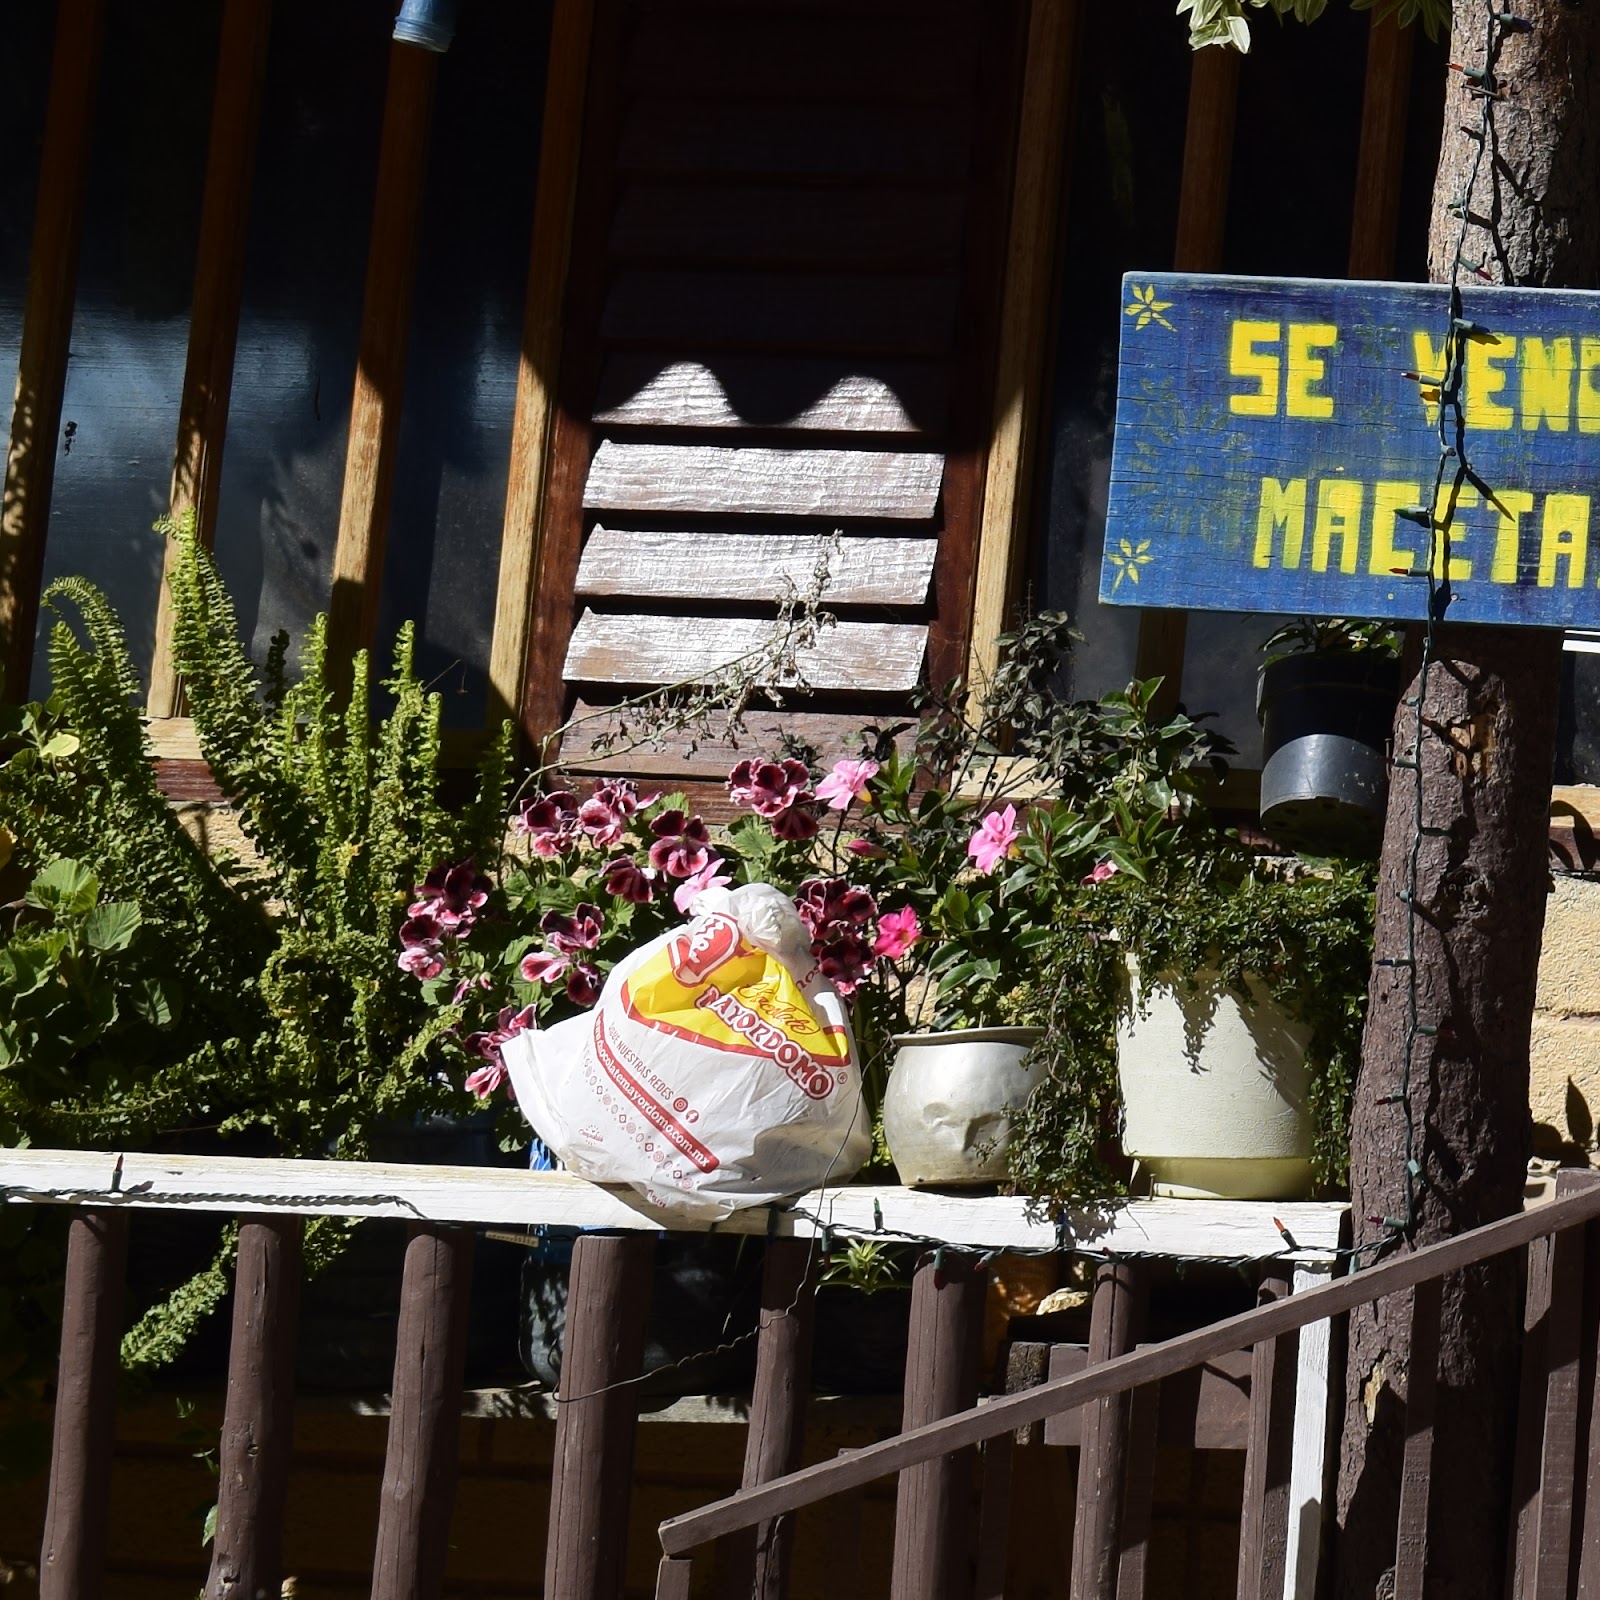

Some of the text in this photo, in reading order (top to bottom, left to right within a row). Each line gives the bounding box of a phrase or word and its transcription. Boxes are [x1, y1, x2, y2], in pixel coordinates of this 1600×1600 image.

[1228, 320, 1338, 418] SE
[616, 1040, 652, 1079] NUESTRAS
[647, 1074, 675, 1101] REDES
